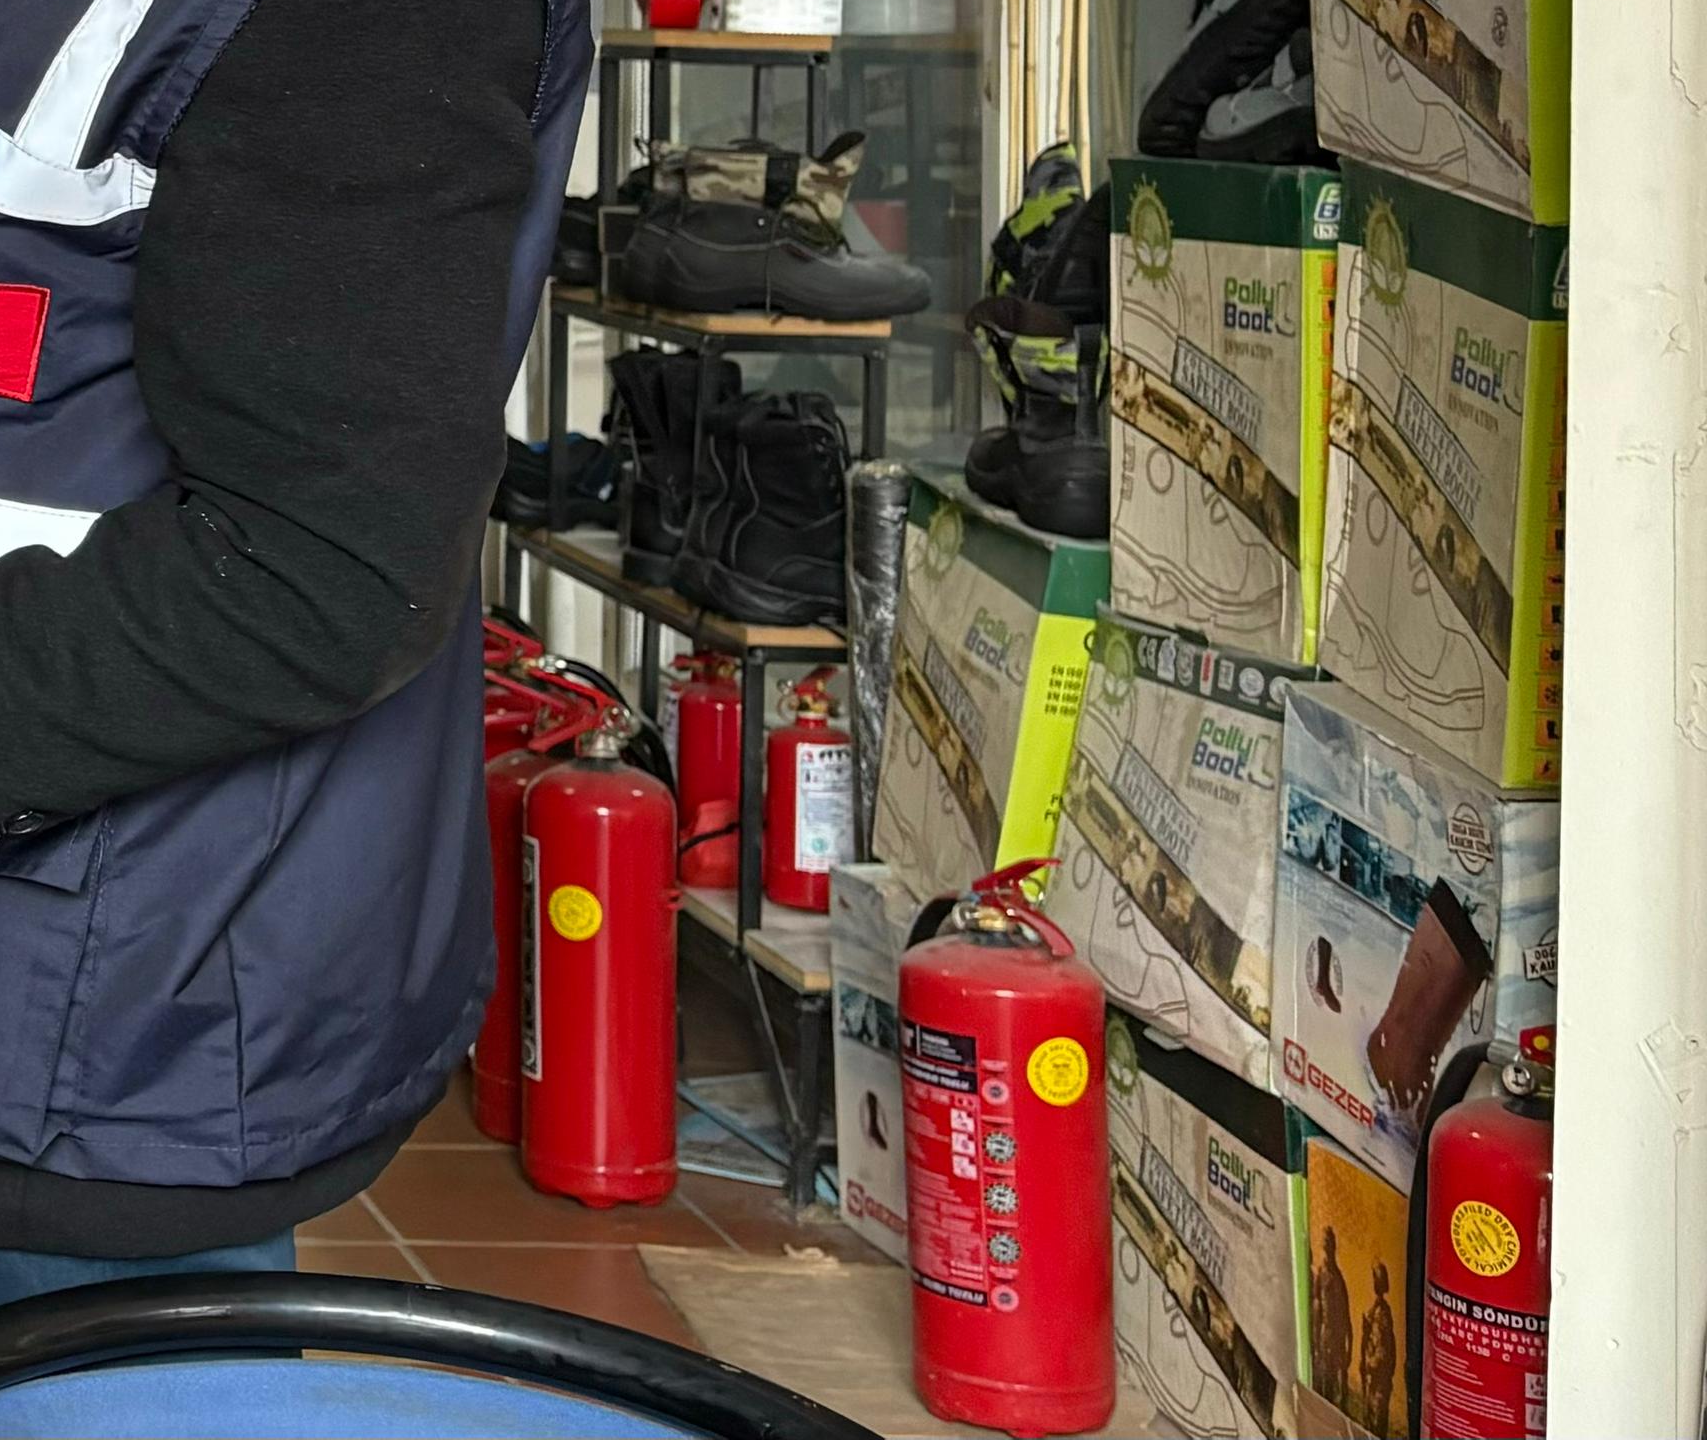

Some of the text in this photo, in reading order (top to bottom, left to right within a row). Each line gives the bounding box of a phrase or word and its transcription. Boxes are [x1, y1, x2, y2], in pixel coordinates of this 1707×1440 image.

[1224, 277, 1274, 309] Polly
[1224, 302, 1273, 333] Boot
[1454, 326, 1505, 379] Polly
[1451, 354, 1502, 404] Boot
[1192, 740, 1247, 781] Boot
[1198, 717, 1254, 761] Polly
[1307, 1062, 1374, 1132] GEZER
[1208, 1159, 1251, 1213] Boot
[1209, 1136, 1251, 1192] Polly
[1493, 1214, 1515, 1239] DRY
